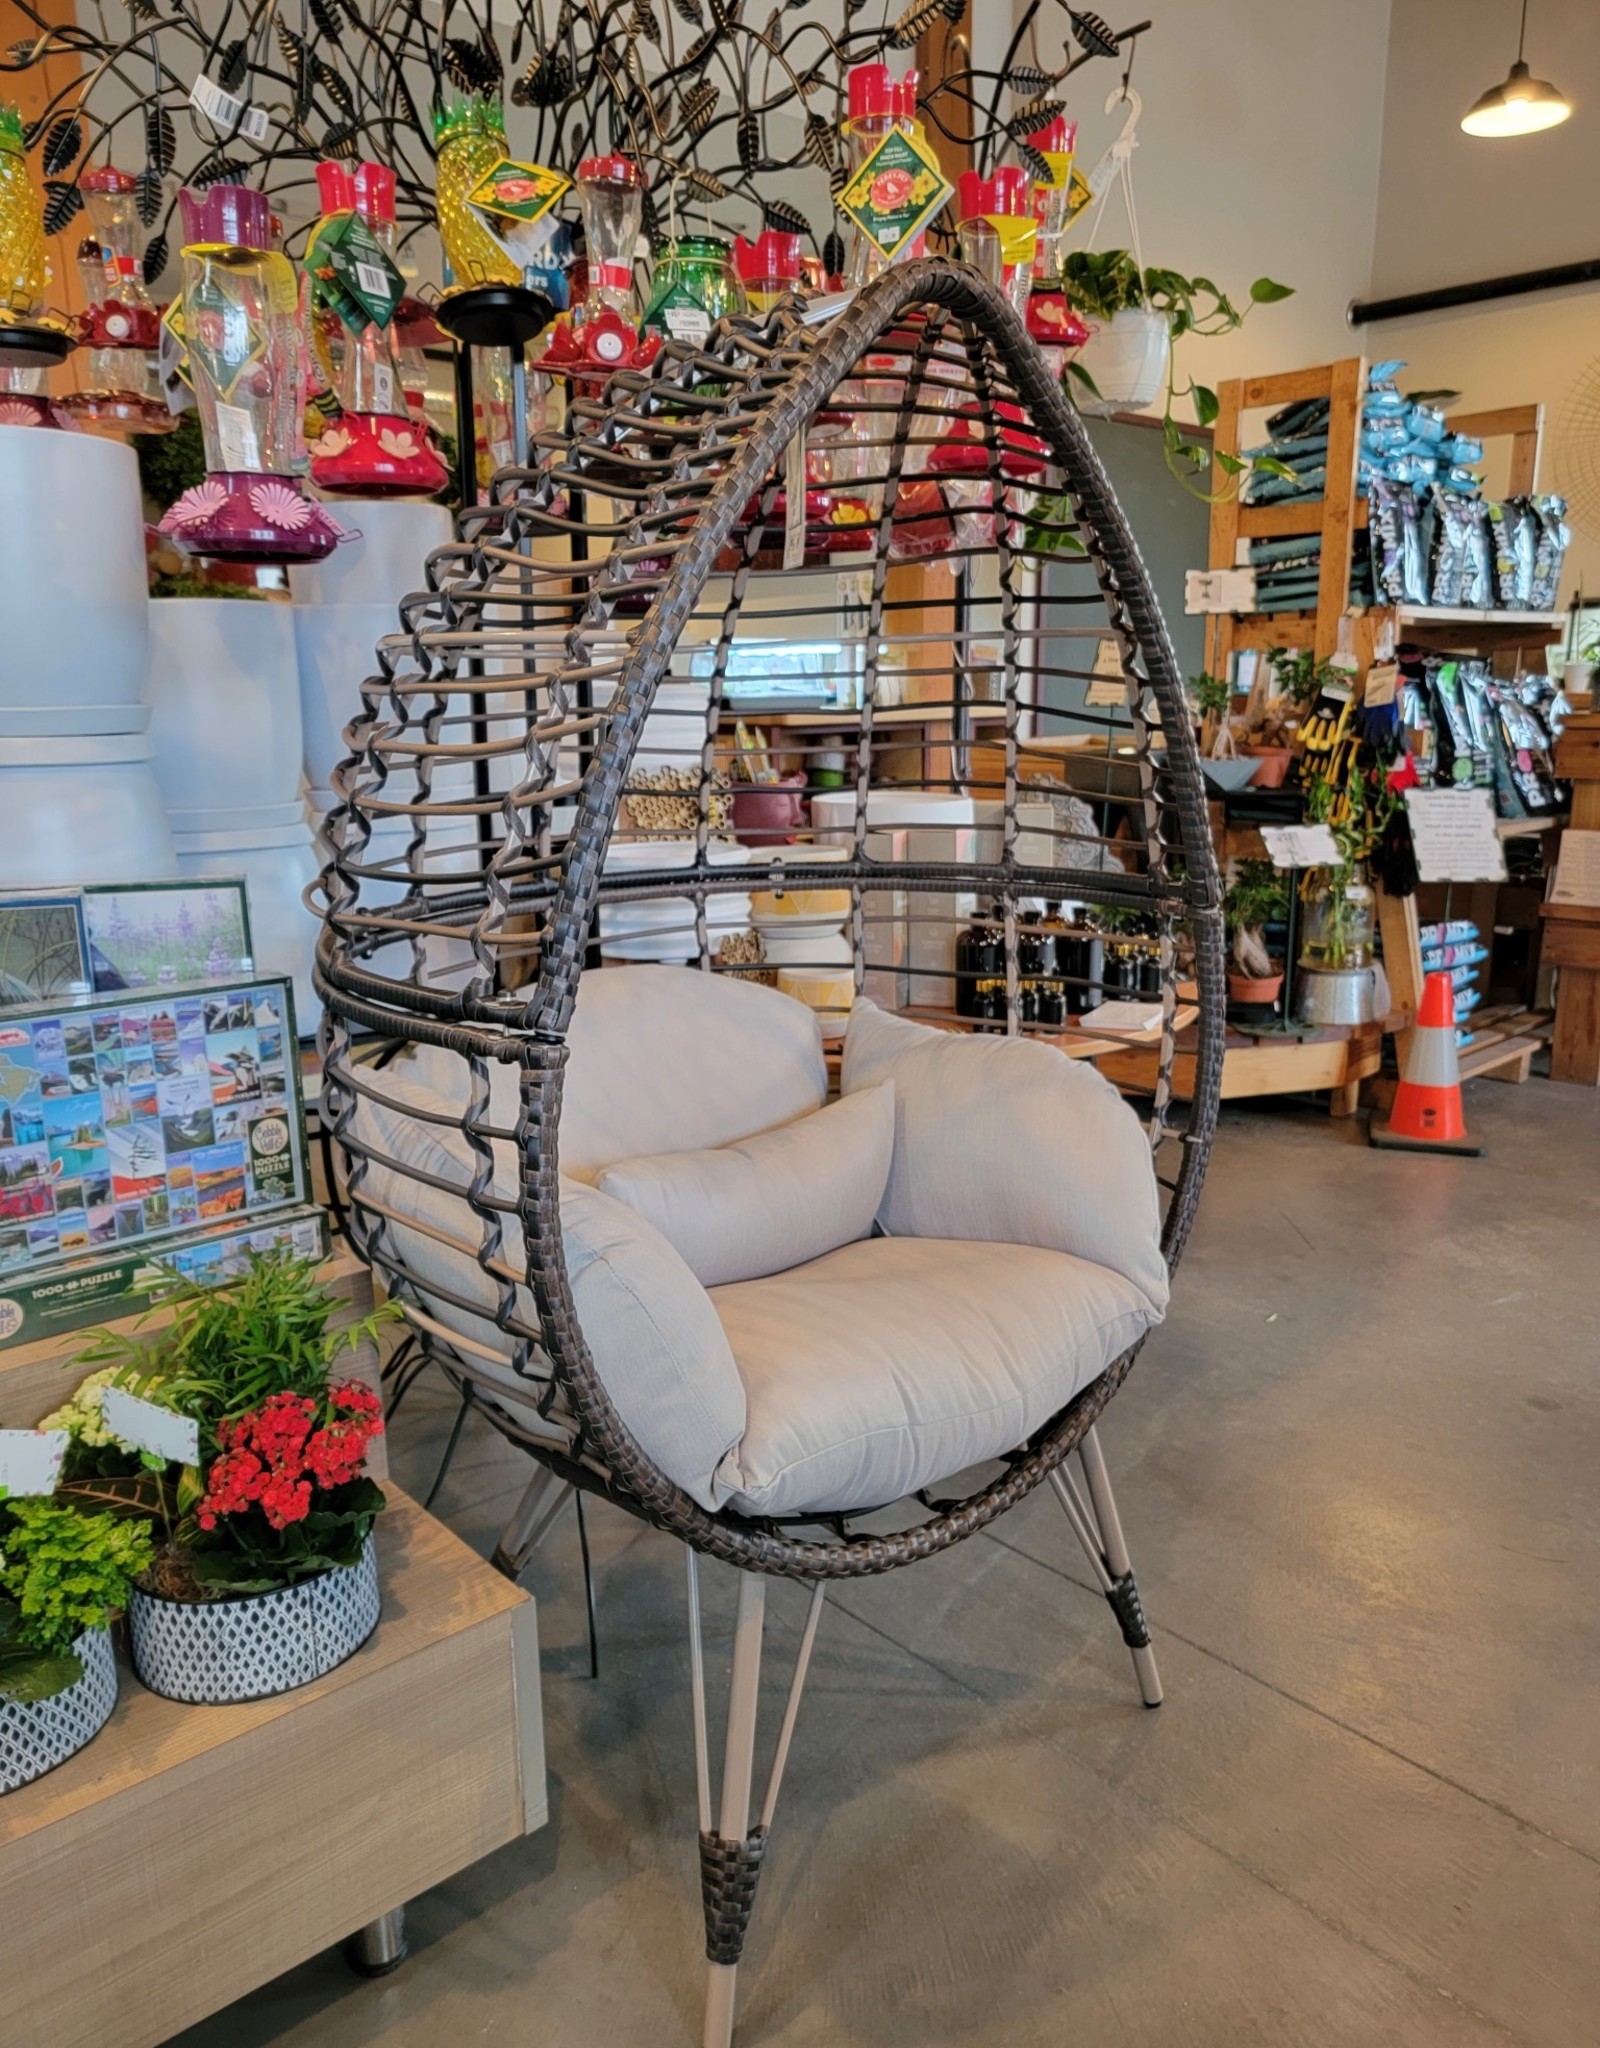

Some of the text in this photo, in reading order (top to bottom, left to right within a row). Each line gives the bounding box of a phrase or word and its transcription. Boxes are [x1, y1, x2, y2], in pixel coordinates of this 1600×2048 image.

[253, 1155, 281, 1167] 1000
[255, 1161, 291, 1176] PUZZLE
[32, 1283, 64, 1300] 1000
[80, 1269, 123, 1288] PUZZLE
